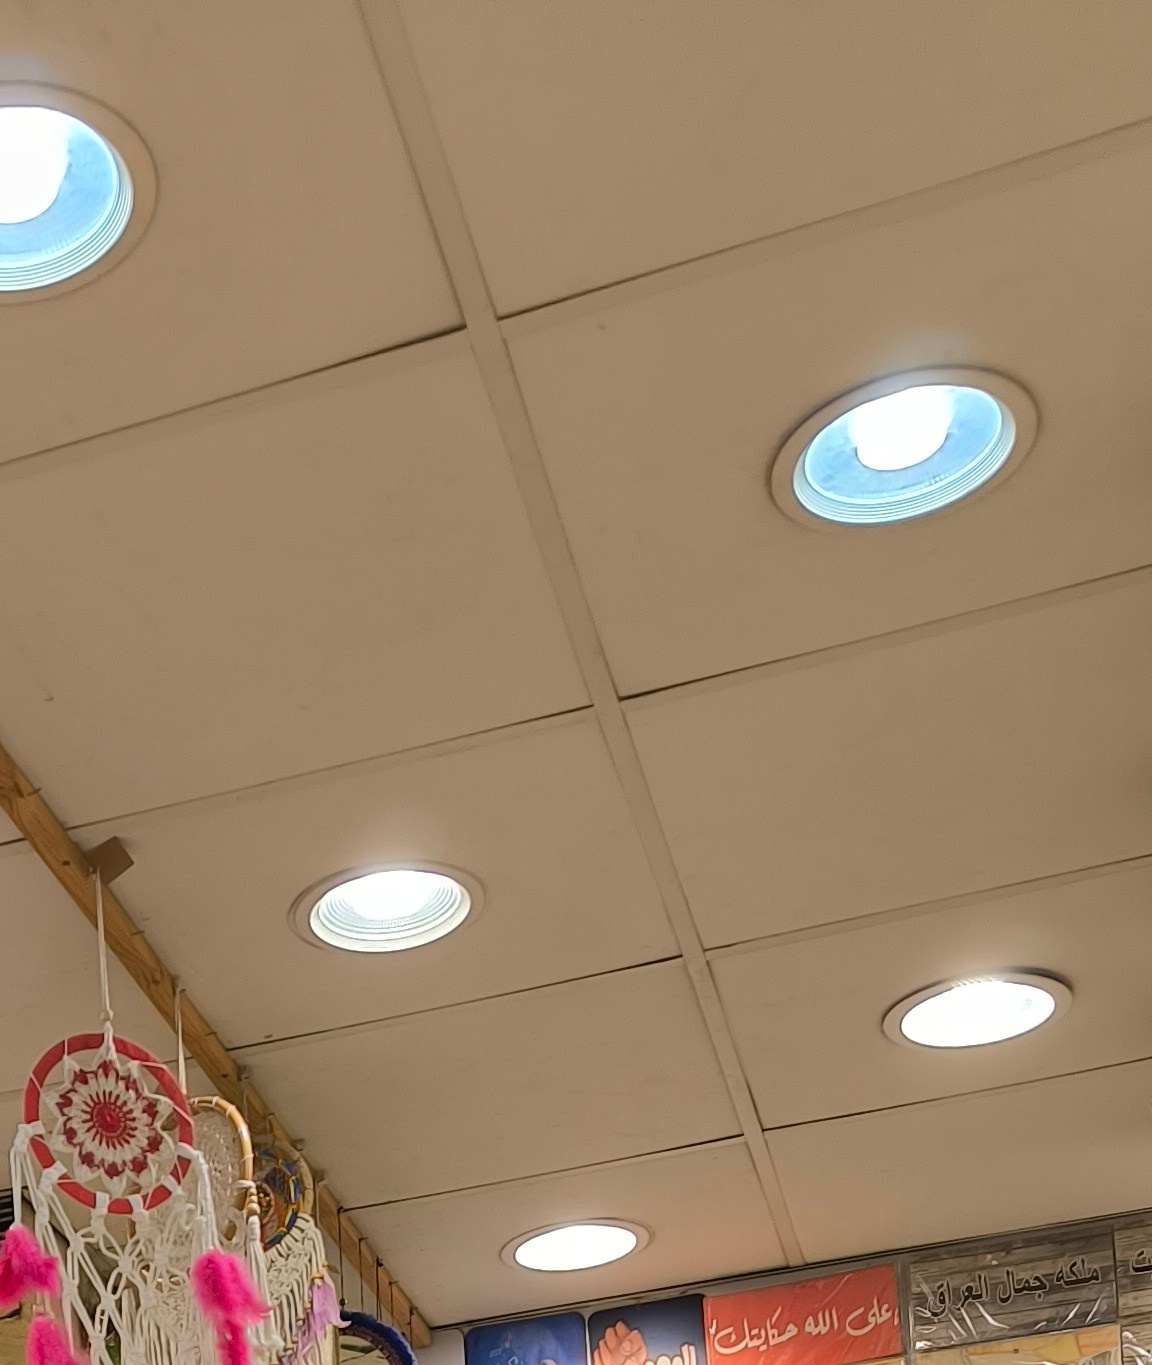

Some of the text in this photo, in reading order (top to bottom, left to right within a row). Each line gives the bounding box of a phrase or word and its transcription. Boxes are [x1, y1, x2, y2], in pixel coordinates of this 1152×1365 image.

[998, 1268, 1048, 1304] جمال
[1055, 1255, 1102, 1288] ملكه
[927, 1272, 990, 1322] العراق
[714, 1306, 799, 1355] حكايتك
[805, 1306, 839, 1336] الله
